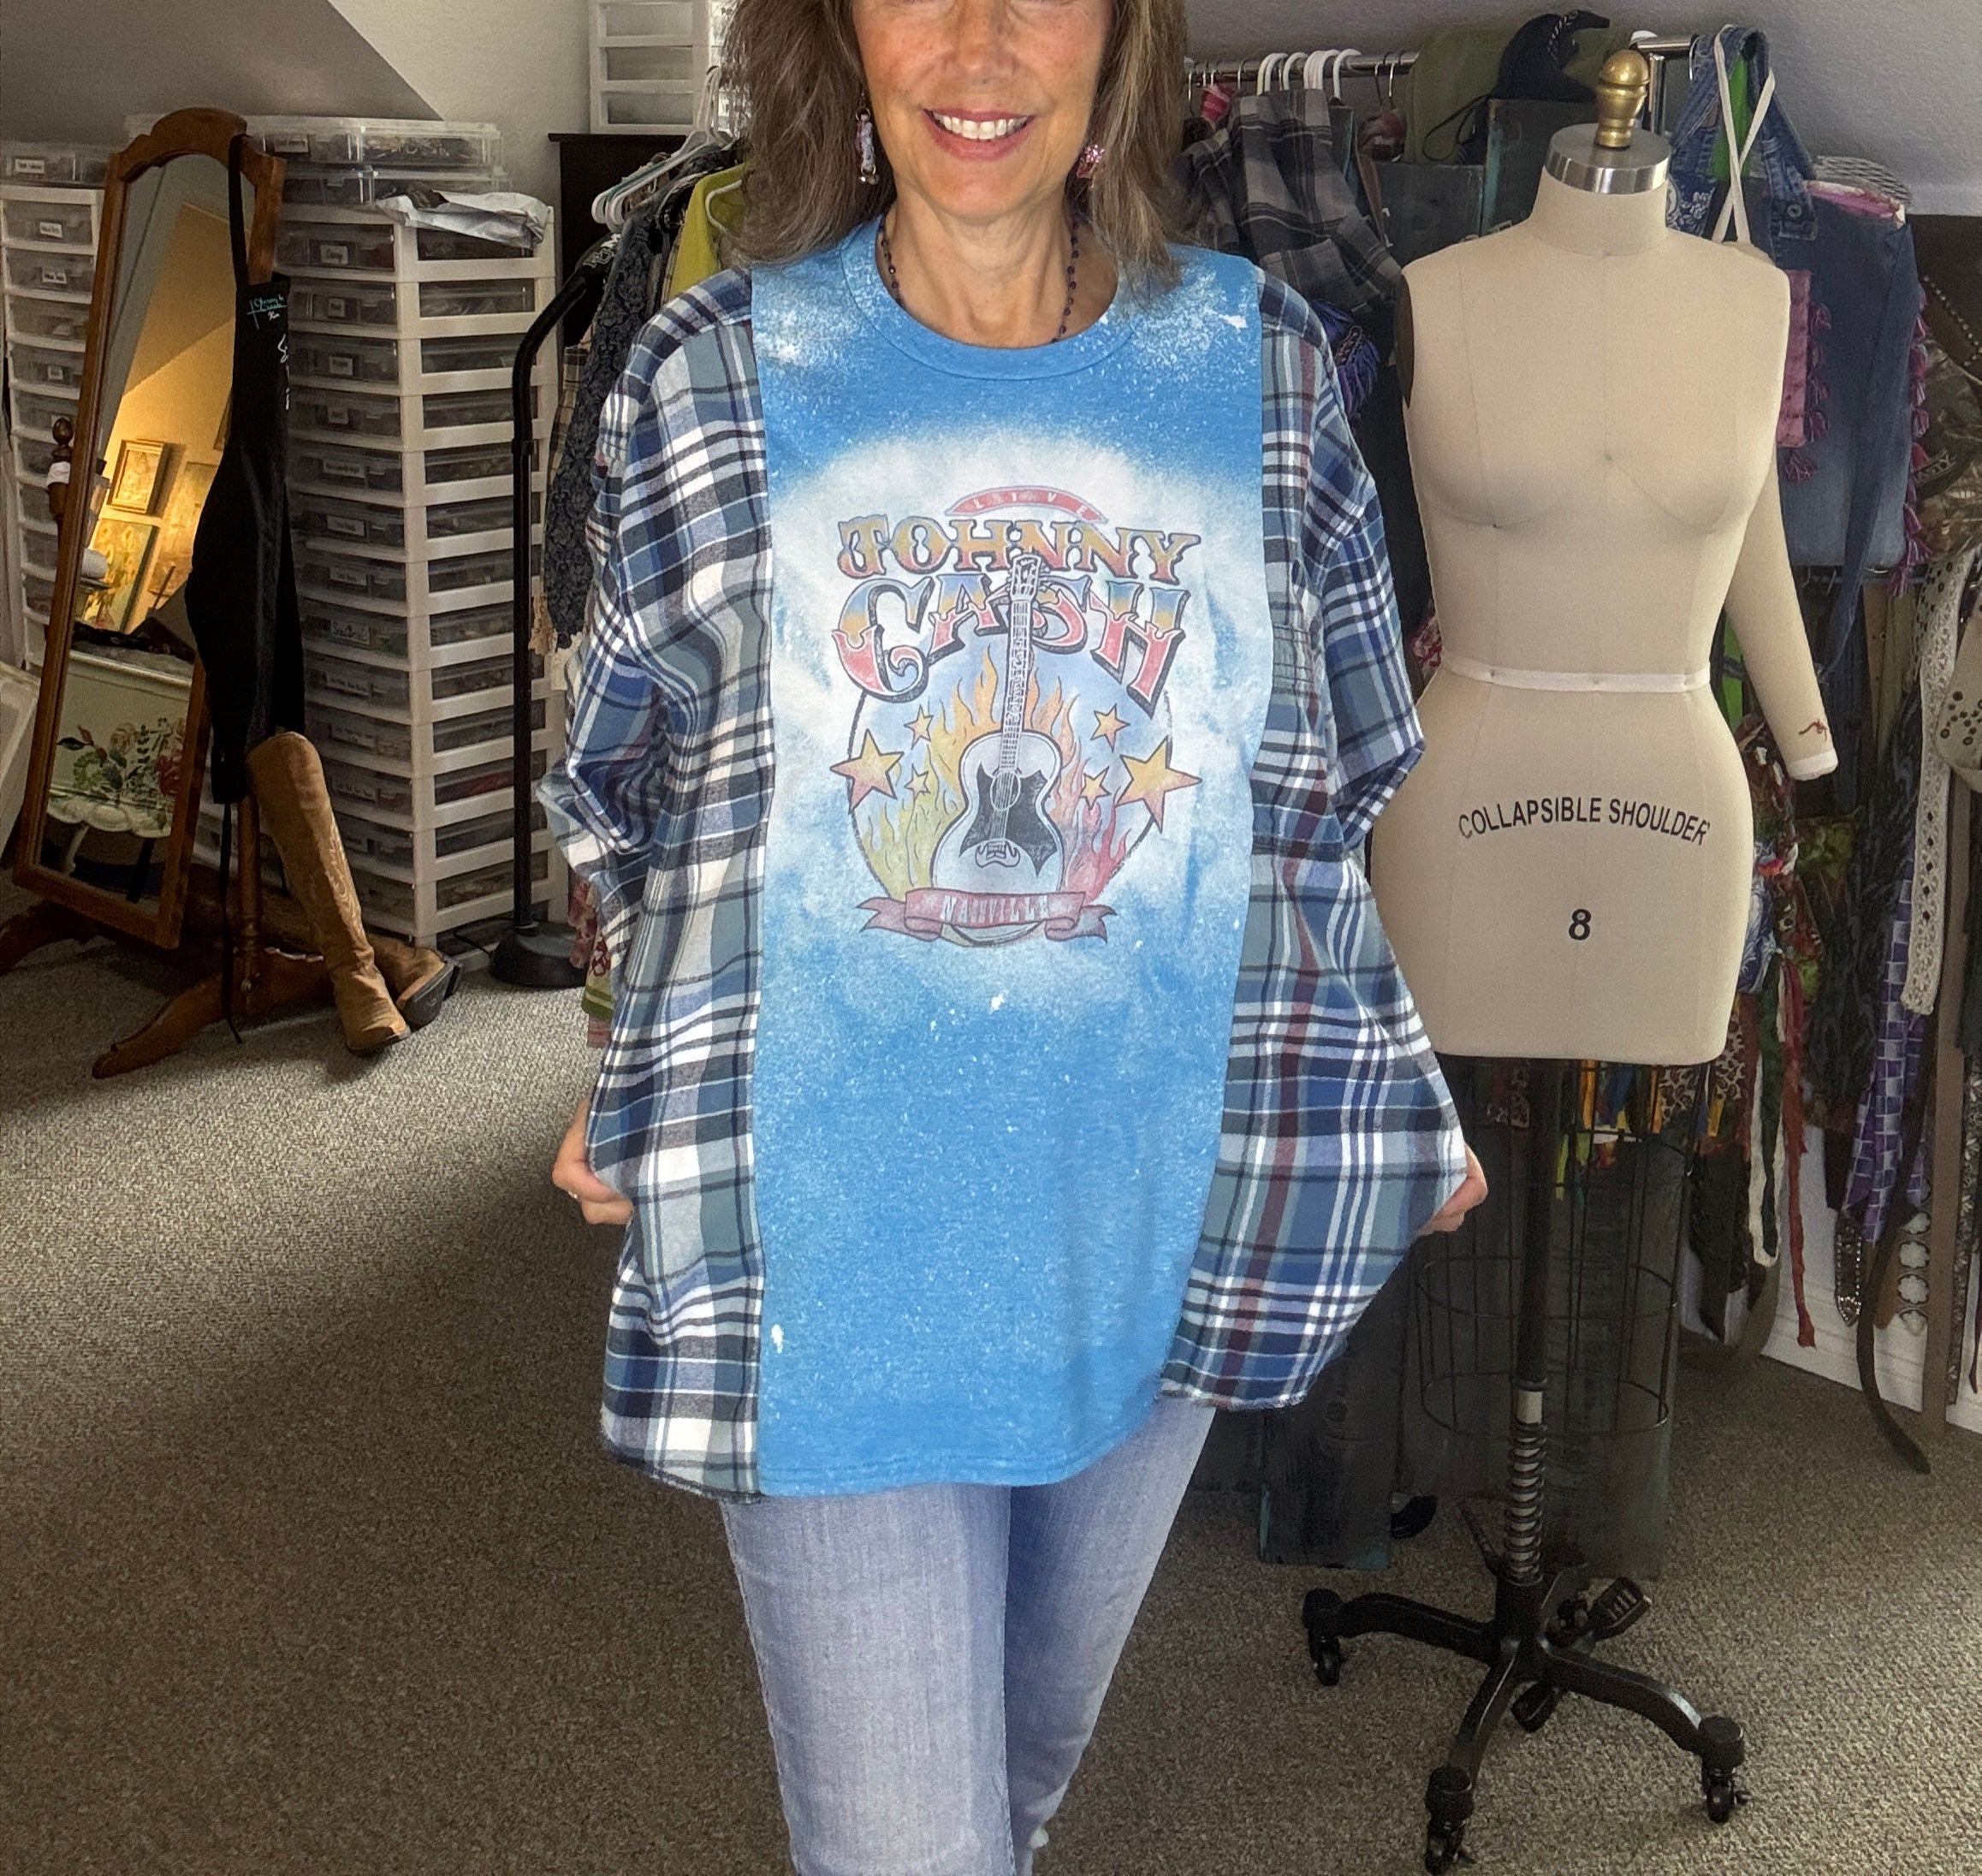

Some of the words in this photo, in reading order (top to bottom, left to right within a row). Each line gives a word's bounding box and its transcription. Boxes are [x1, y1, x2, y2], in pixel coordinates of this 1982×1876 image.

[972, 491, 1089, 515] LIVE
[837, 514, 1202, 585] JOHNNY
[832, 573, 1191, 718] CASH
[1458, 796, 1602, 839] COLLAPSIBLE
[1608, 798, 1711, 846] SHOULDER
[1569, 908, 1592, 941] 8
